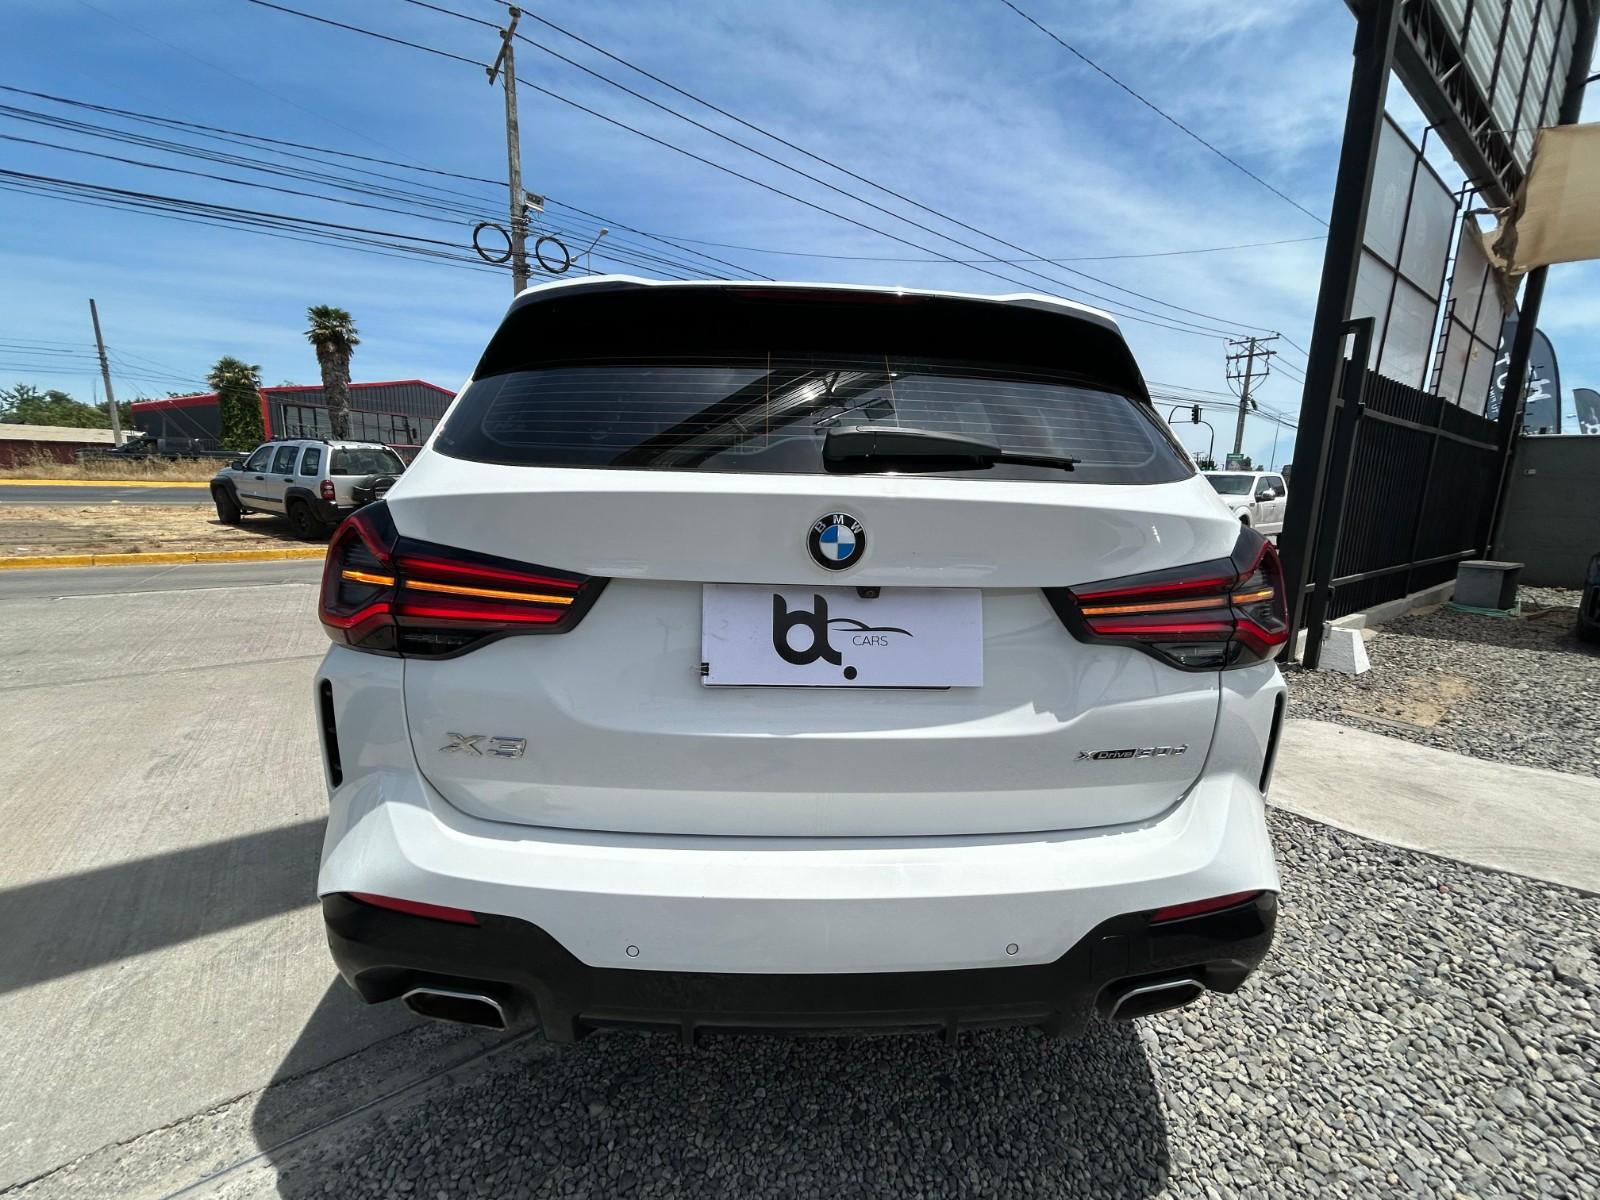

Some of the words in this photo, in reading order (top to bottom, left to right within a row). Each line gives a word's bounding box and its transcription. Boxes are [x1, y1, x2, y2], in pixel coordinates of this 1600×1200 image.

[814, 514, 863, 534] BMW
[852, 635, 889, 646] CARS
[439, 732, 527, 759] X3
